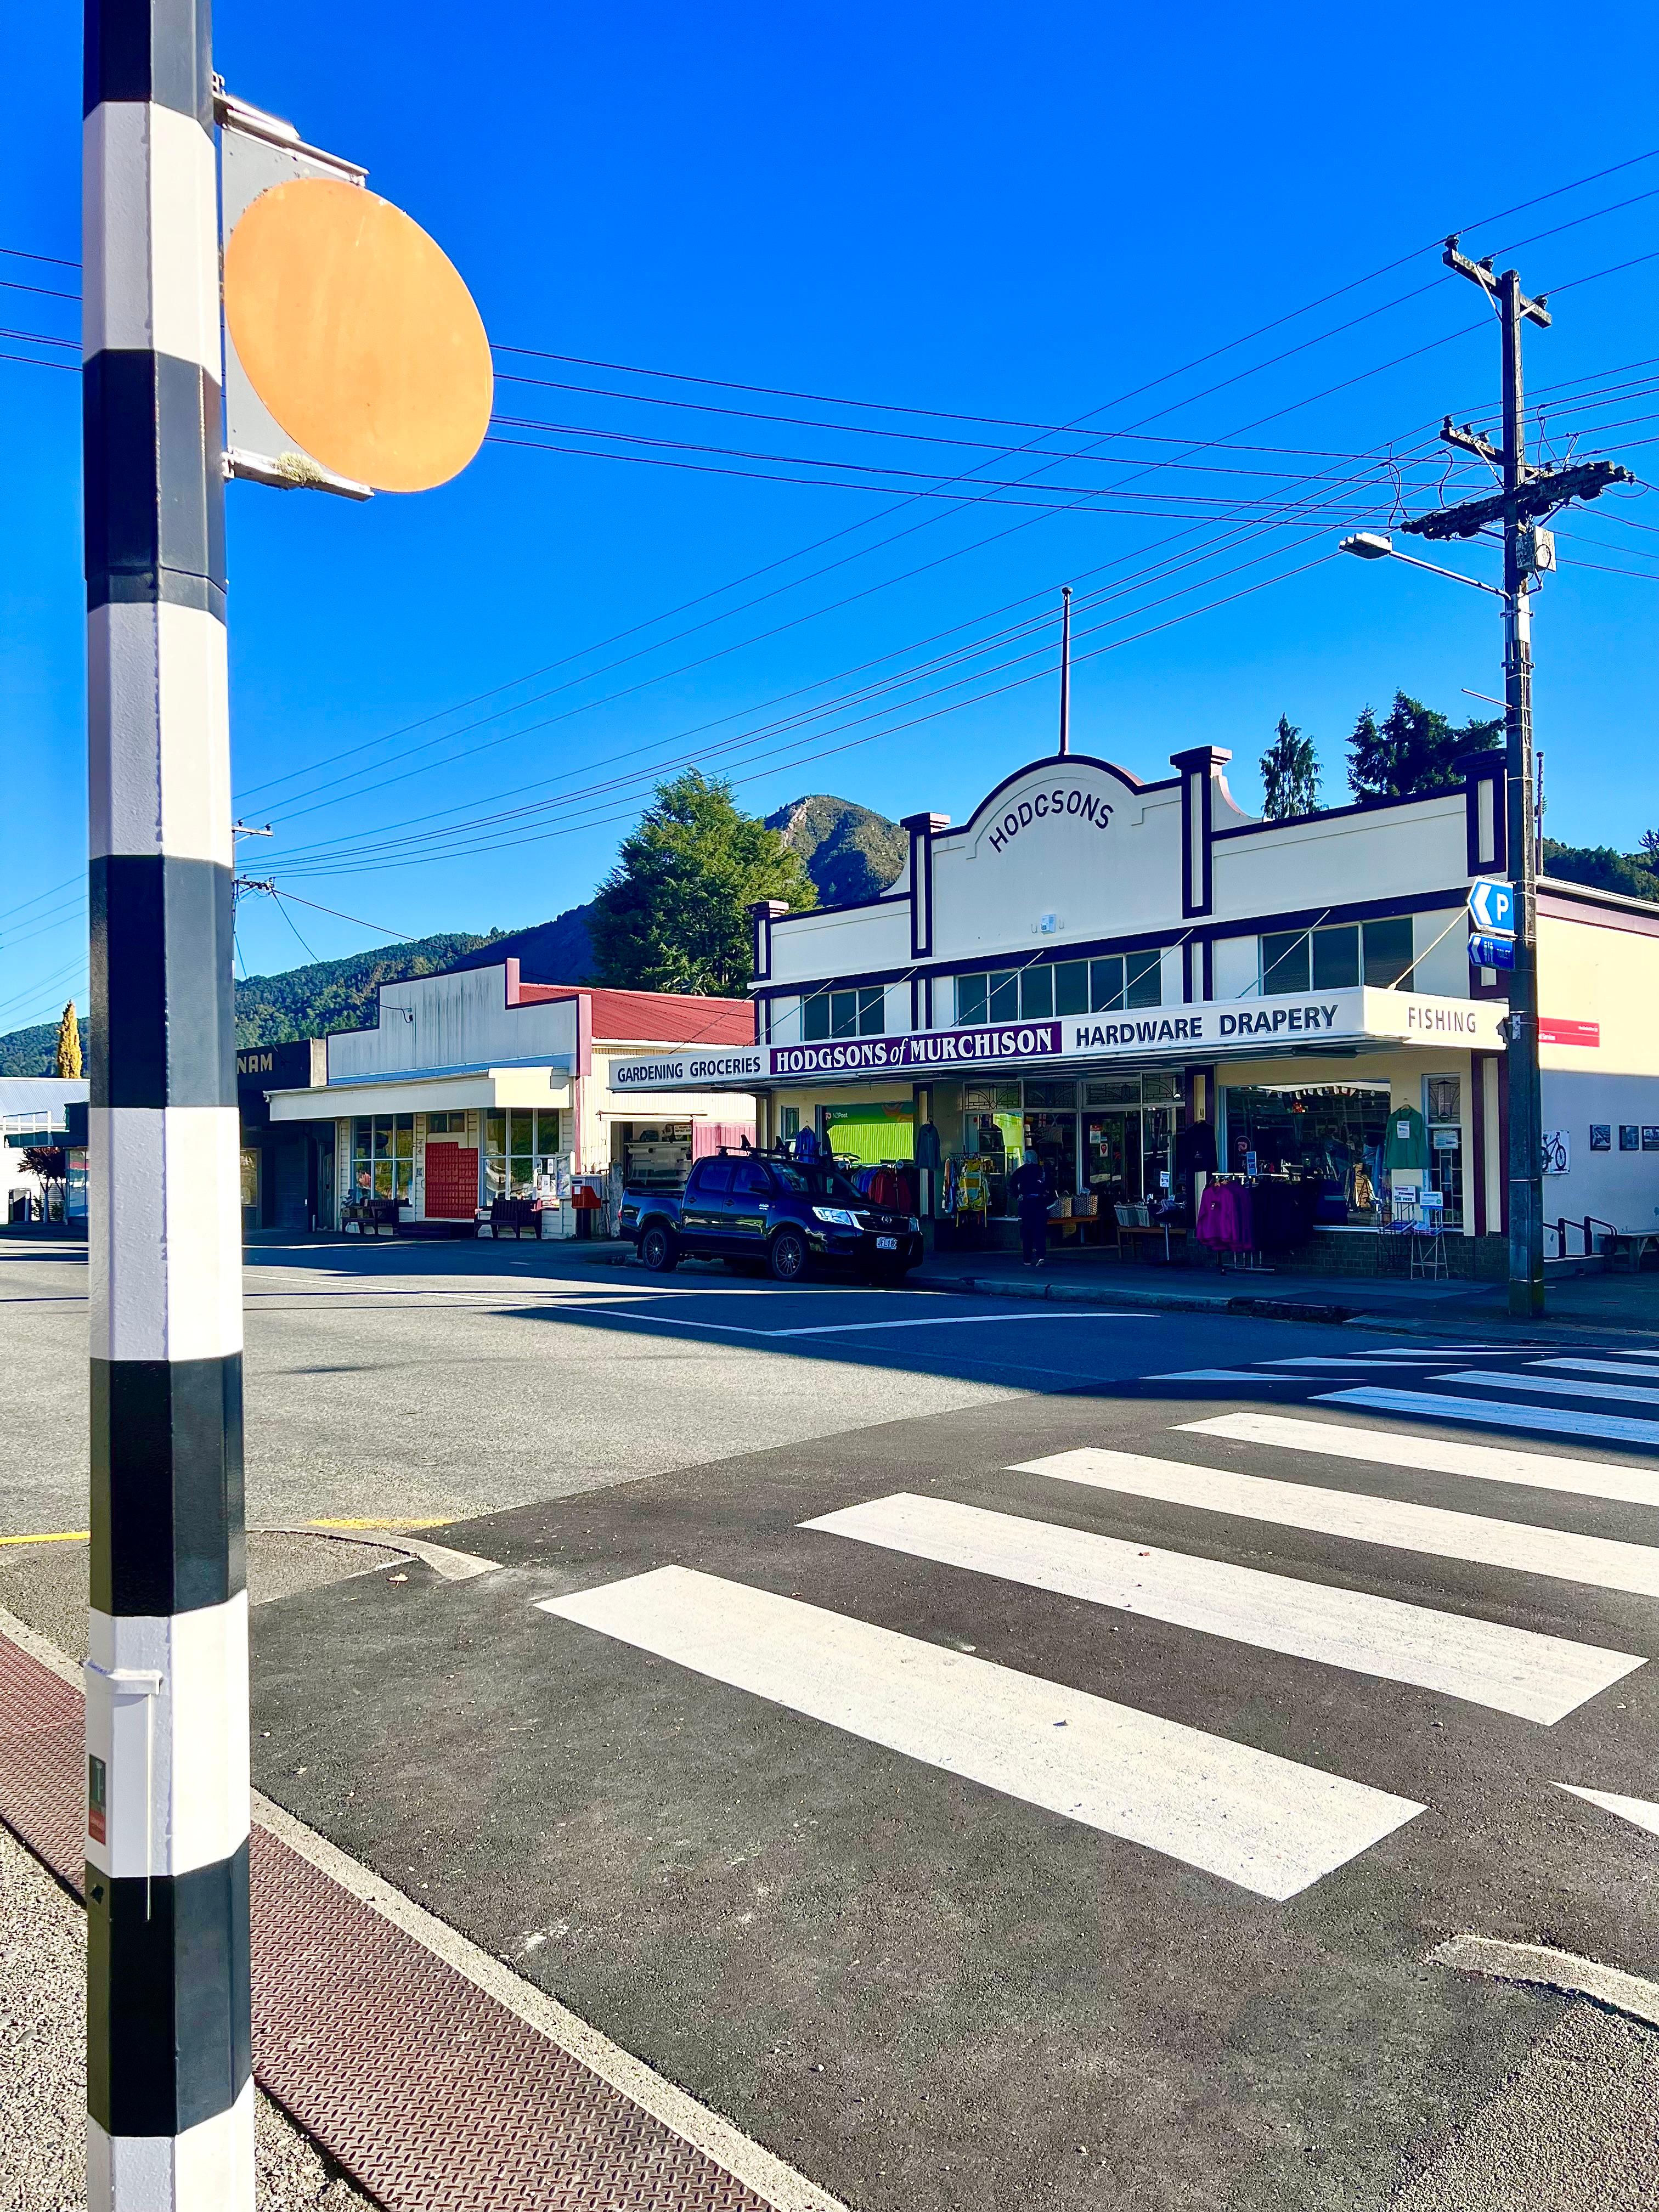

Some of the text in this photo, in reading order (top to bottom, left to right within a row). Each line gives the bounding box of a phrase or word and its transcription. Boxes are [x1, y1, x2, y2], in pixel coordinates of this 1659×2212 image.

[989, 790, 1114, 853] HODGSONS
[1497, 893, 1509, 921] P
[1076, 1005, 1339, 1048] HARDWARE DRAPERY
[1409, 1007, 1476, 1032] FISHING
[776, 1028, 1052, 1071] HODGSONS of MURCHISON
[618, 1057, 760, 1082] GARDENING GROCERIES
